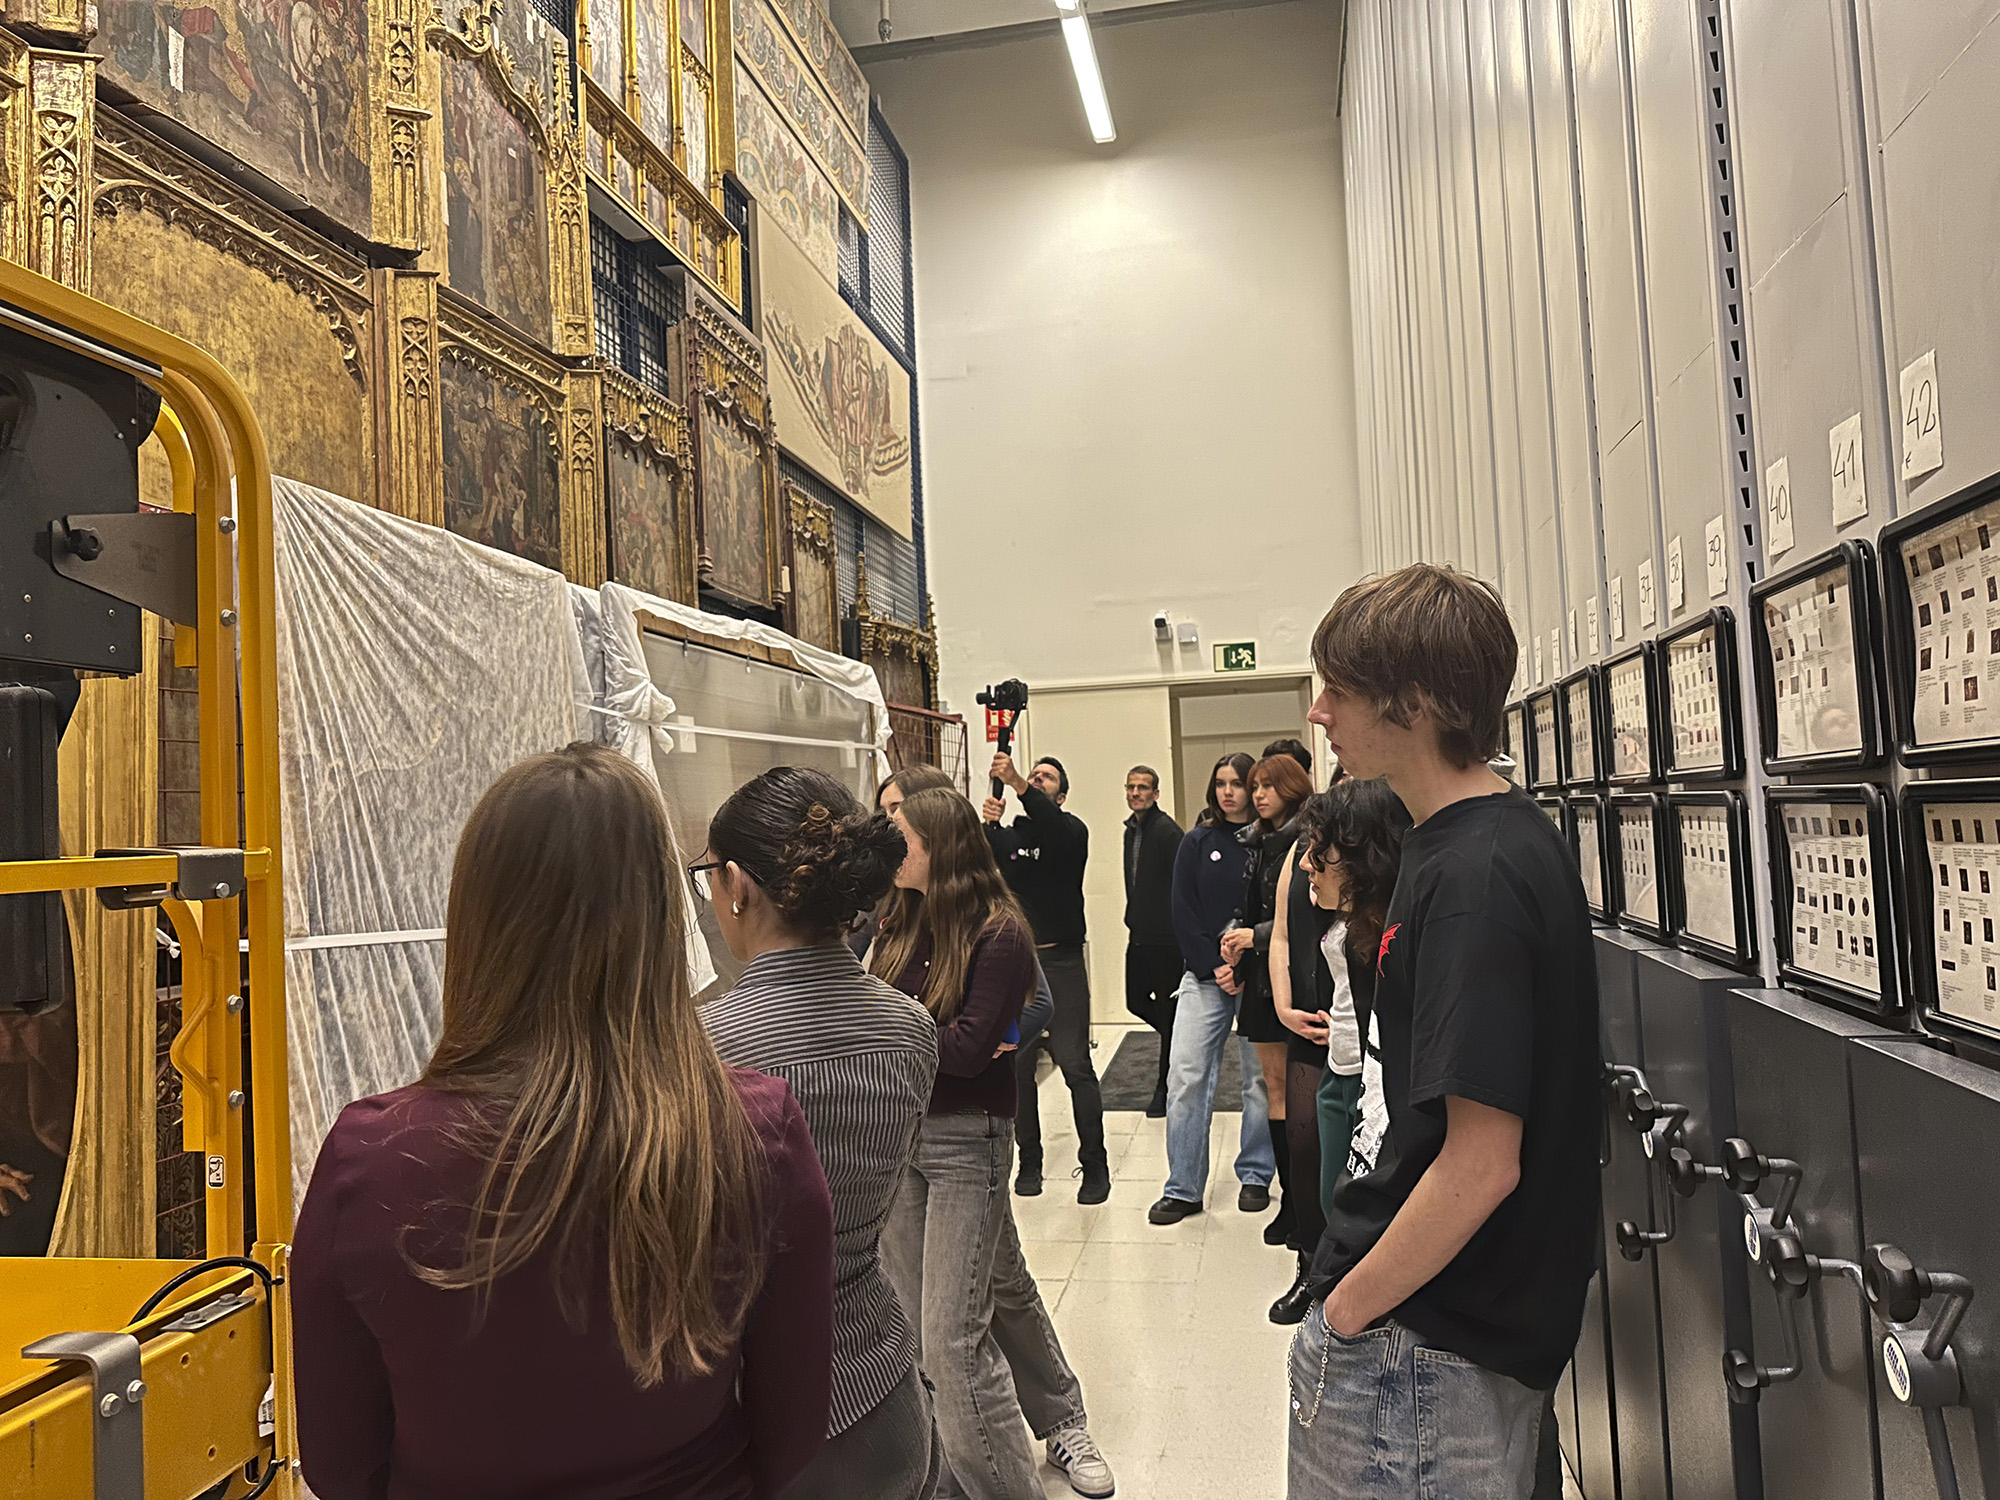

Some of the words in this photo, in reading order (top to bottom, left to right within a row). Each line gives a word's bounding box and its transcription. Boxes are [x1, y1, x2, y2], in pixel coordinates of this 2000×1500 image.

[1907, 379, 1936, 440] 42
[1834, 439, 1856, 488] 41
[1770, 484, 1788, 524] 40
[1670, 553, 1680, 583] 38
[1708, 534, 1721, 567] 39
